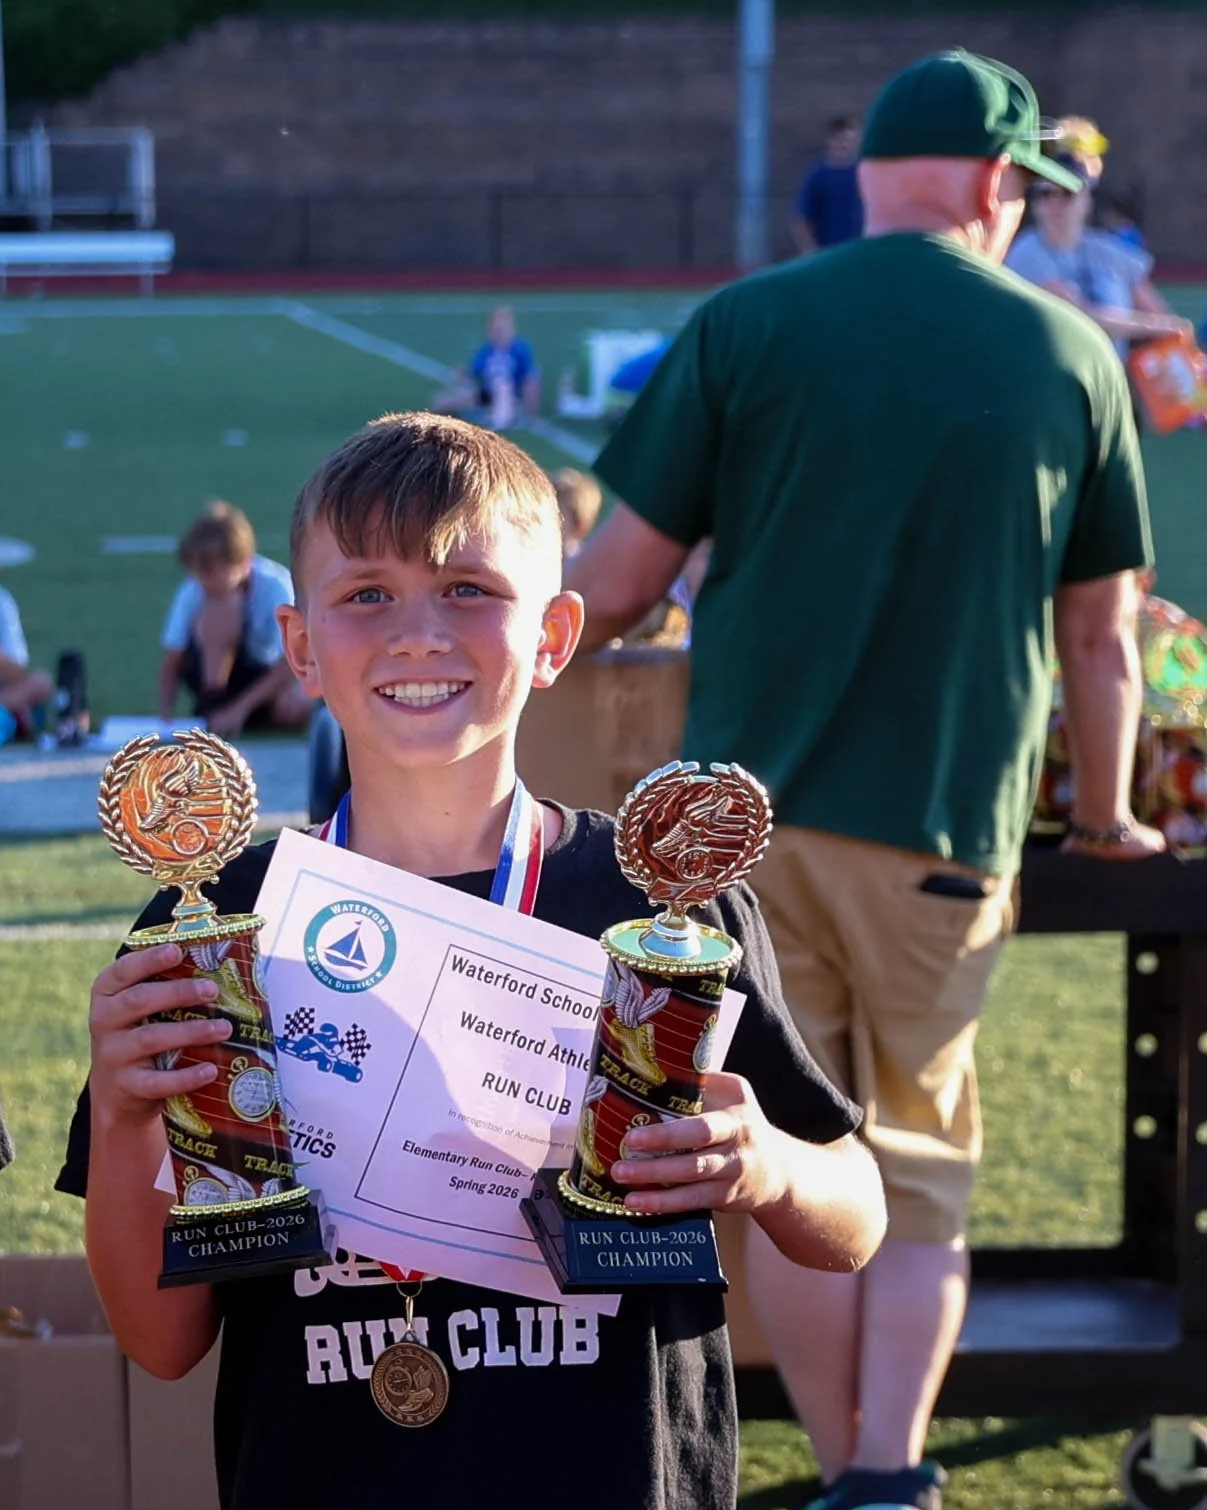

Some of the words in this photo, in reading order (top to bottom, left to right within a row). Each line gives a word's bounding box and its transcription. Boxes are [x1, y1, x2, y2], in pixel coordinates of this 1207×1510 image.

[330, 903, 389, 932] WATERFORD
[451, 954, 538, 1000] Waterford
[540, 987, 599, 1022] School
[460, 1011, 545, 1056] Waterford
[600, 1053, 652, 1096] TRACK
[481, 1072, 521, 1099] RUN
[525, 1087, 572, 1116] CLUB
[458, 1113, 503, 1134] recognition
[167, 1128, 218, 1159] TRACK
[402, 1139, 469, 1167] Elementary
[469, 1156, 493, 1172] Run
[449, 1175, 487, 1195] Spring
[487, 1183, 520, 1200] 2026
[172, 1227, 207, 1244] RUN
[188, 1231, 290, 1258] CHAMPION
[579, 1231, 613, 1246] RUN
[597, 1251, 694, 1268] CHAMPION
[447, 1306, 601, 1371] CLUB
